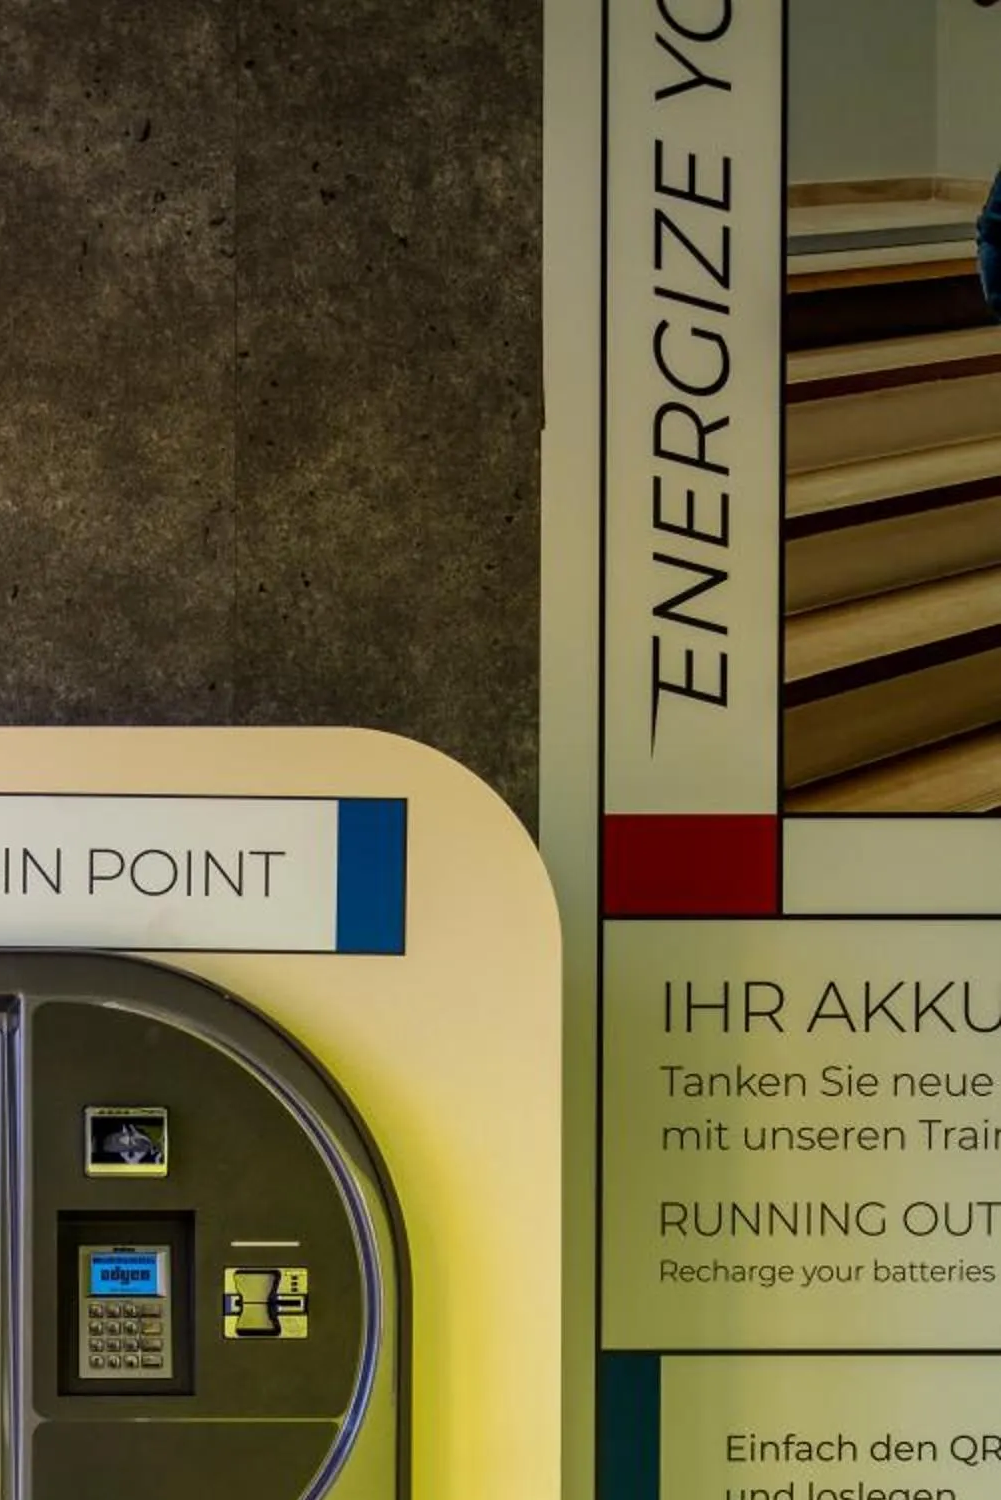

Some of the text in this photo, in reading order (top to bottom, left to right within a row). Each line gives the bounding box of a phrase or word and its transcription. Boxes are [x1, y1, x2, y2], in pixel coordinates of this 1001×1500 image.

[650, 138, 732, 753] ENERGIZE
[88, 848, 286, 897] POINT
[664, 980, 1001, 1034] IHR AKKU
[659, 1064, 994, 1098] Tanken Sie neue
[662, 1119, 729, 1151] mit
[743, 1126, 905, 1151] unseren
[660, 1201, 1001, 1238] RUNNING OUT
[659, 1258, 996, 1288] Recharge your batteries
[726, 1433, 1001, 1467] Einfach den QR
